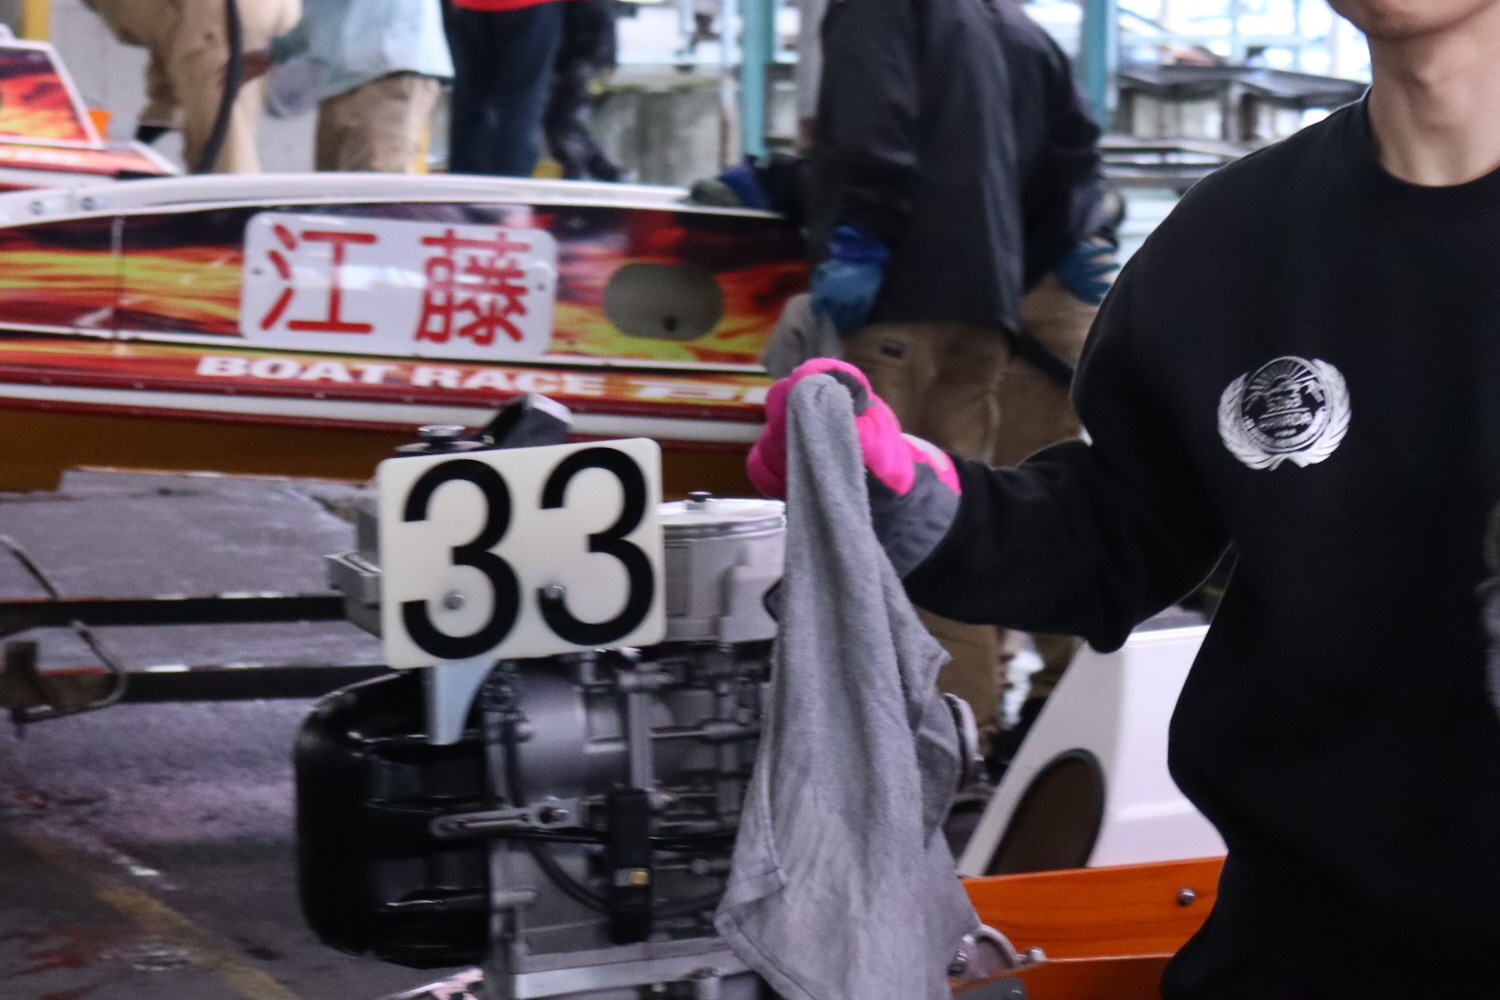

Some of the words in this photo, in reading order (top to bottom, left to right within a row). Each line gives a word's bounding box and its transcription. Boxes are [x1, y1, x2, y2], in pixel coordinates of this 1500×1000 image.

[259, 224, 531, 346] 江藤
[196, 355, 399, 385] BOAT
[410, 365, 605, 396] RACE
[402, 447, 655, 661] 33
